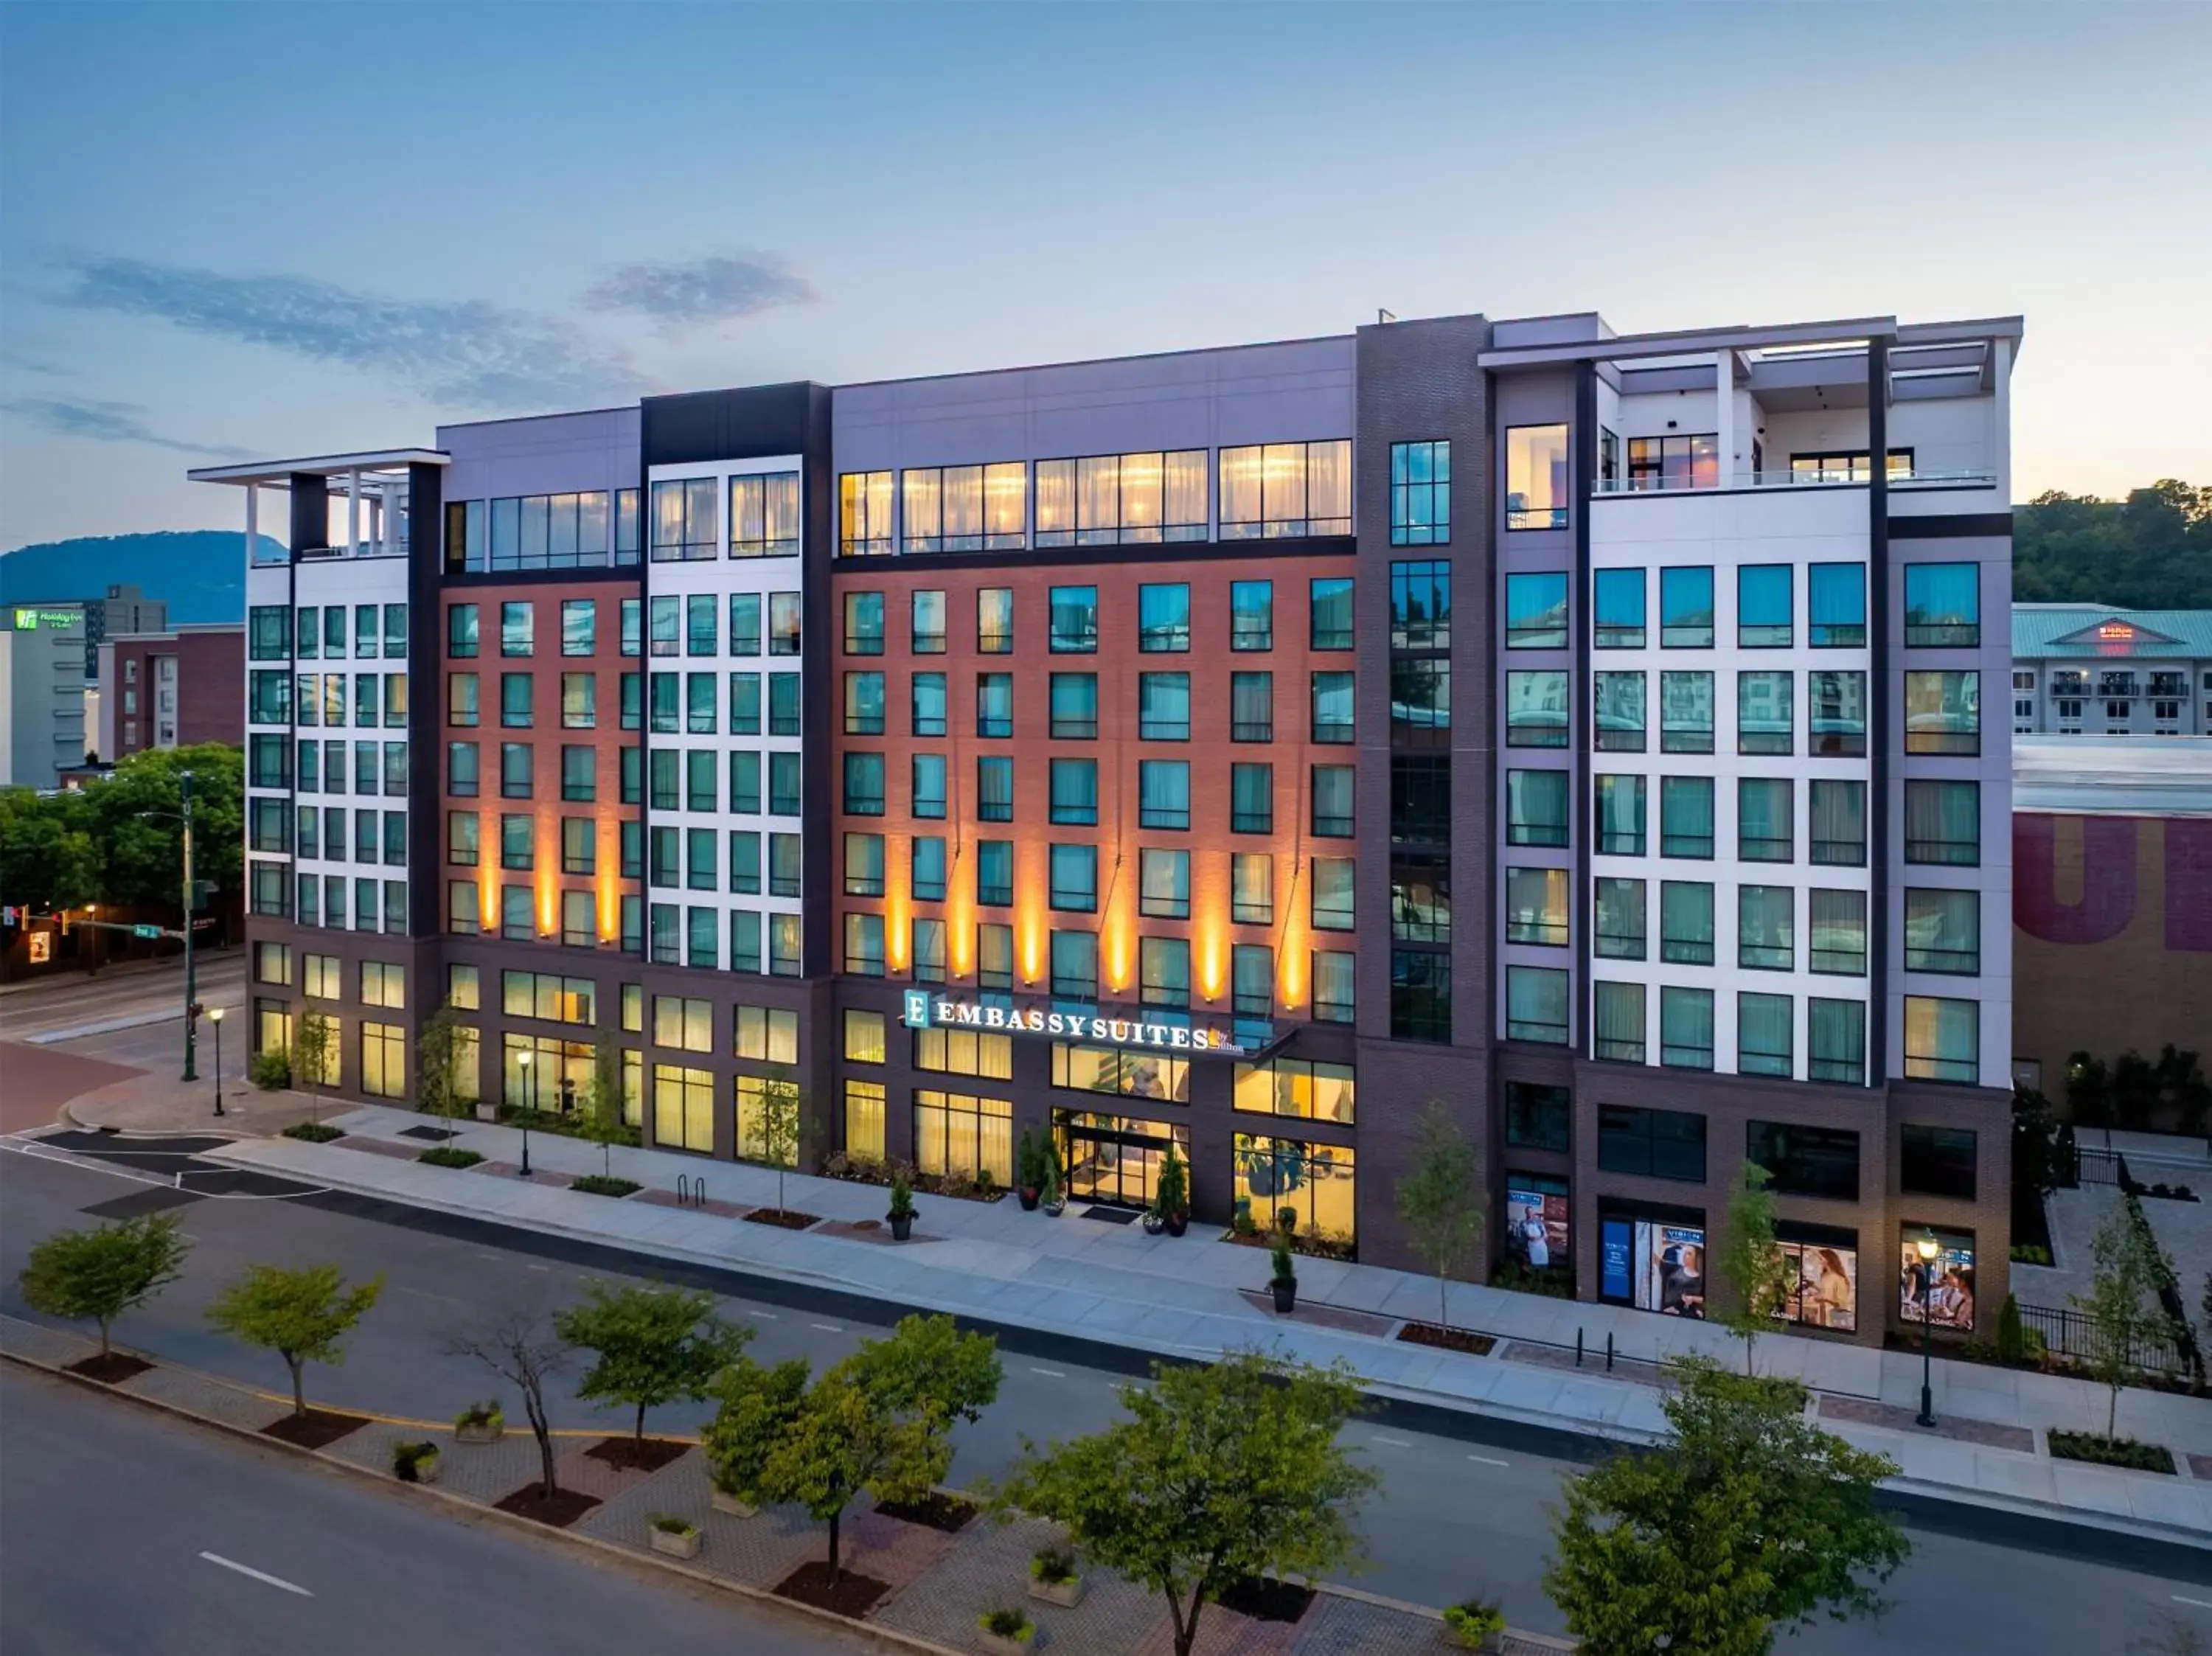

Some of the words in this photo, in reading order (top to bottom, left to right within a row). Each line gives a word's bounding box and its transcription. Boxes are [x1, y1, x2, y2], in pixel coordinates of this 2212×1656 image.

[909, 997, 925, 1021] E
[937, 1002, 1086, 1036] EMBASSY
[1092, 1018, 1208, 1049] SUITES
[1512, 1194, 1540, 1202] VISIN
[1669, 1231, 1700, 1239] VISIN
